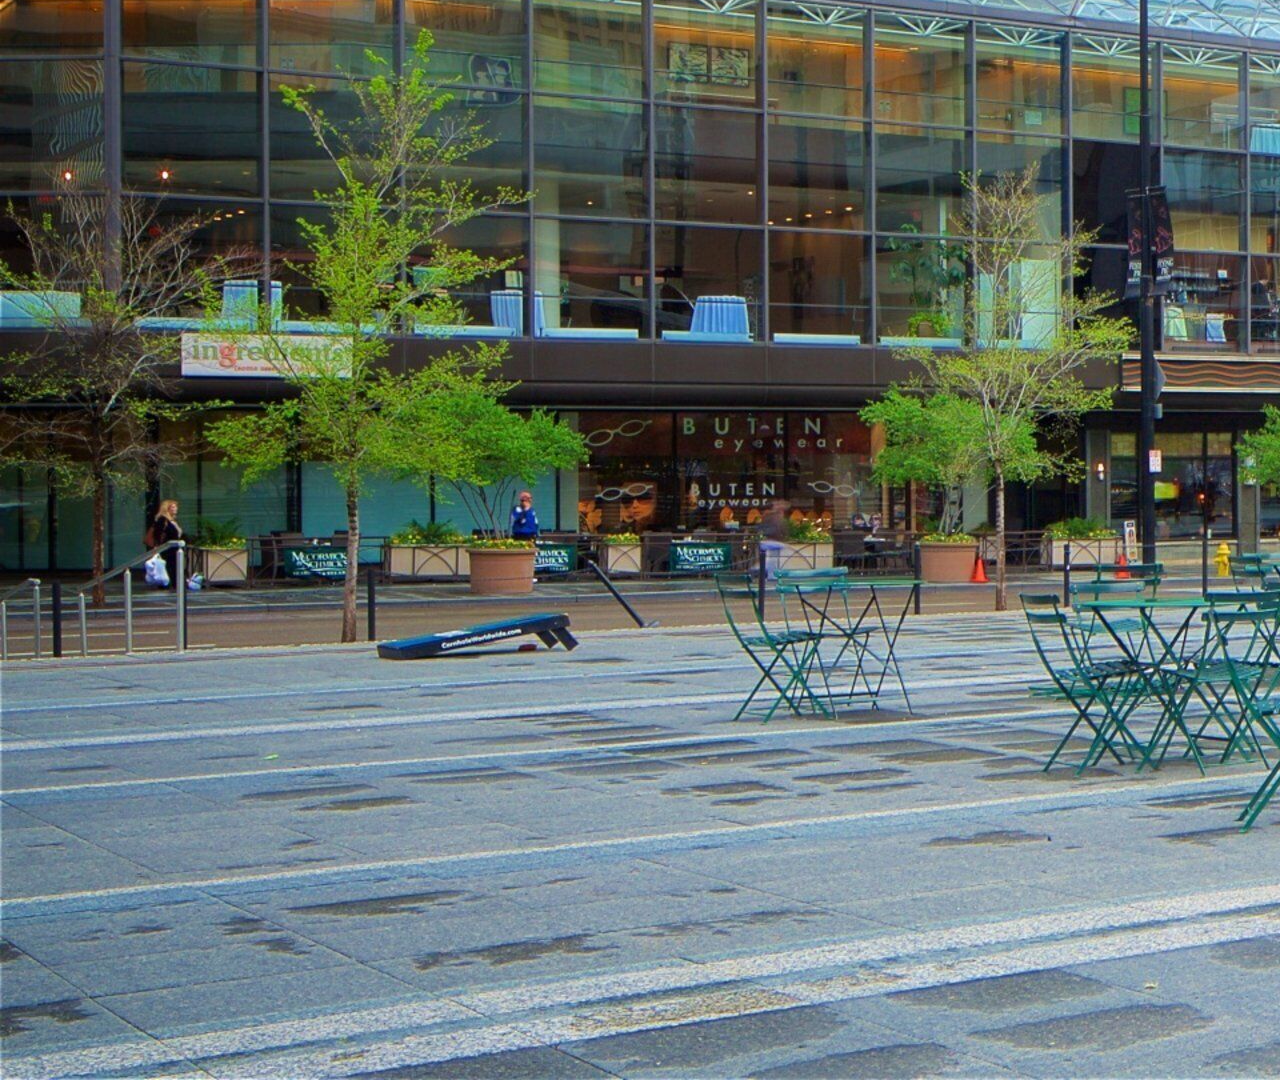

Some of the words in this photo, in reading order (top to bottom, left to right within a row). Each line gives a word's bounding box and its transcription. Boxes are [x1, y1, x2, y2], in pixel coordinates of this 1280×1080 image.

[686, 417, 821, 435] BUTEN
[714, 437, 843, 452] eyewear
[691, 482, 775, 497] BUTEN
[698, 497, 768, 510] eyewear
